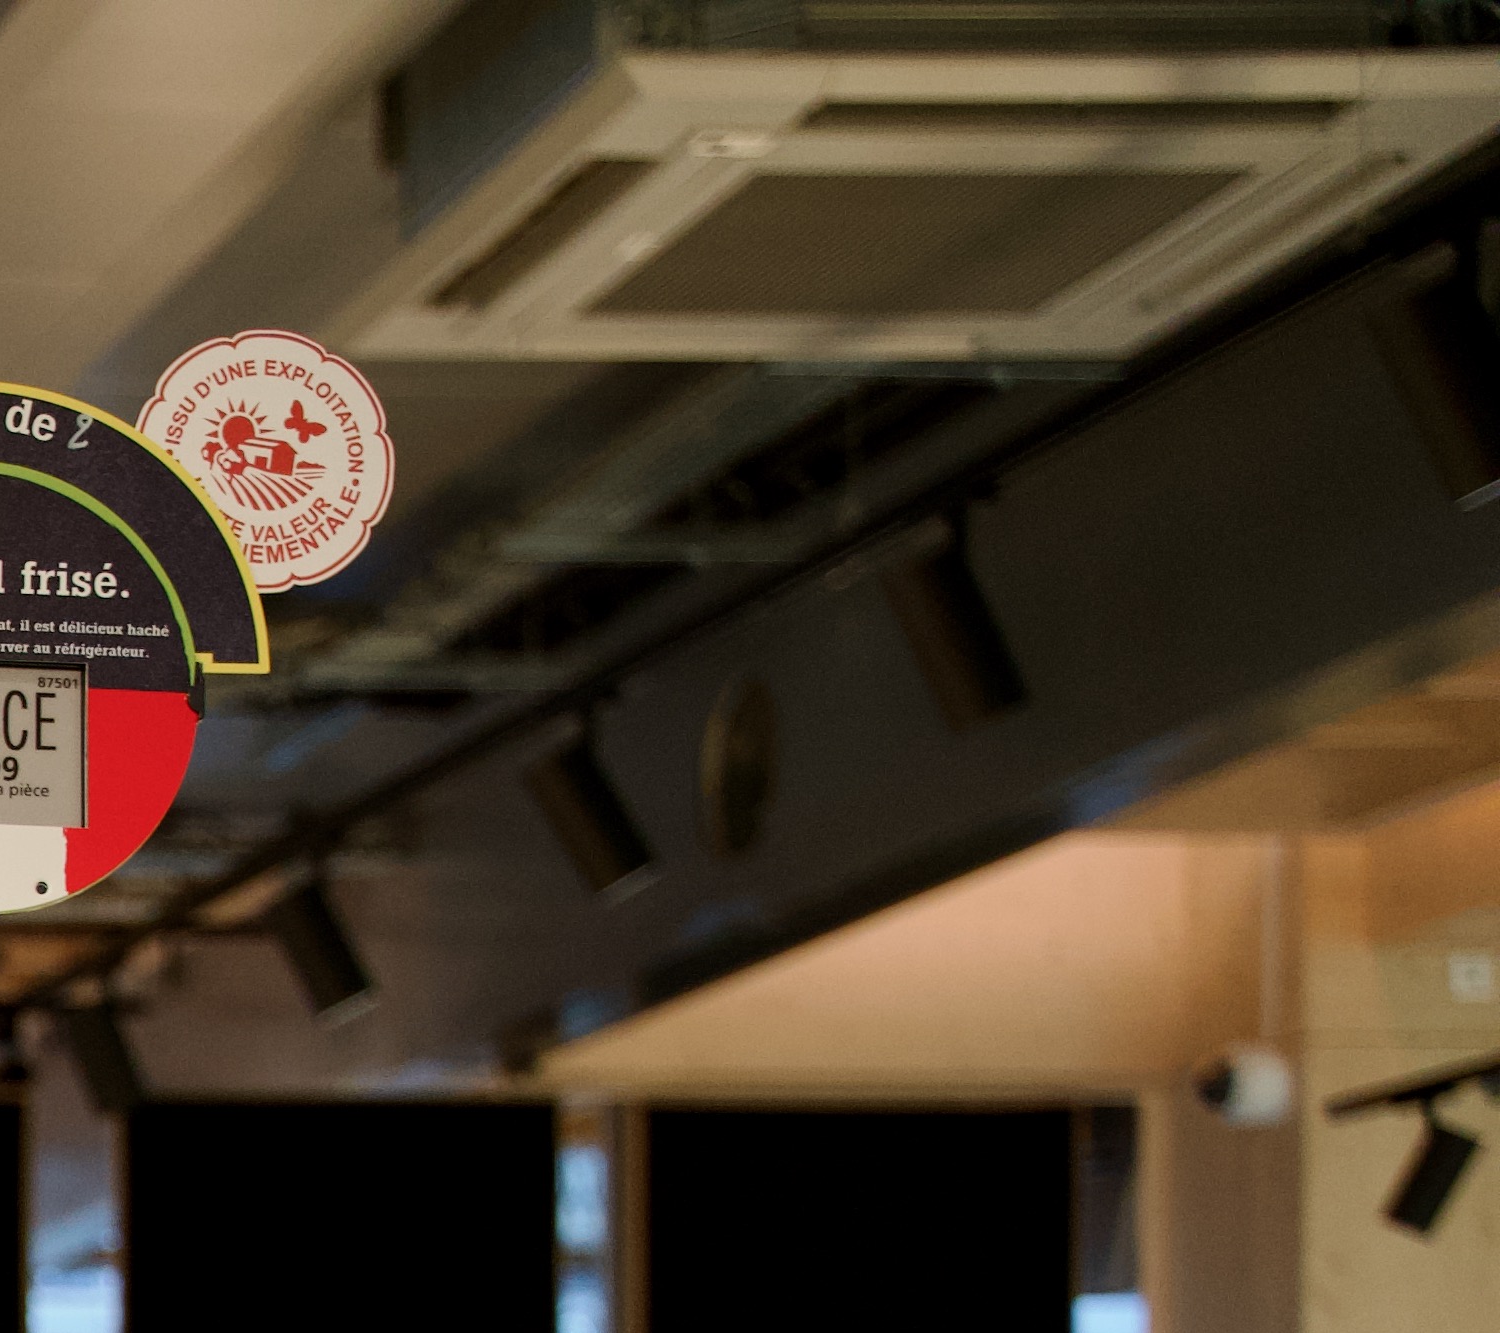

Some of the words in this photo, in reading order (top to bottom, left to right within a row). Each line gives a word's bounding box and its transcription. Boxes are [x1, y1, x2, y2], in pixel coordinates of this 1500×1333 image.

[5, 399, 57, 441] de
[21, 561, 132, 599] frisé.
[37, 677, 79, 689] 87501
[9, 783, 50, 799] pièce
